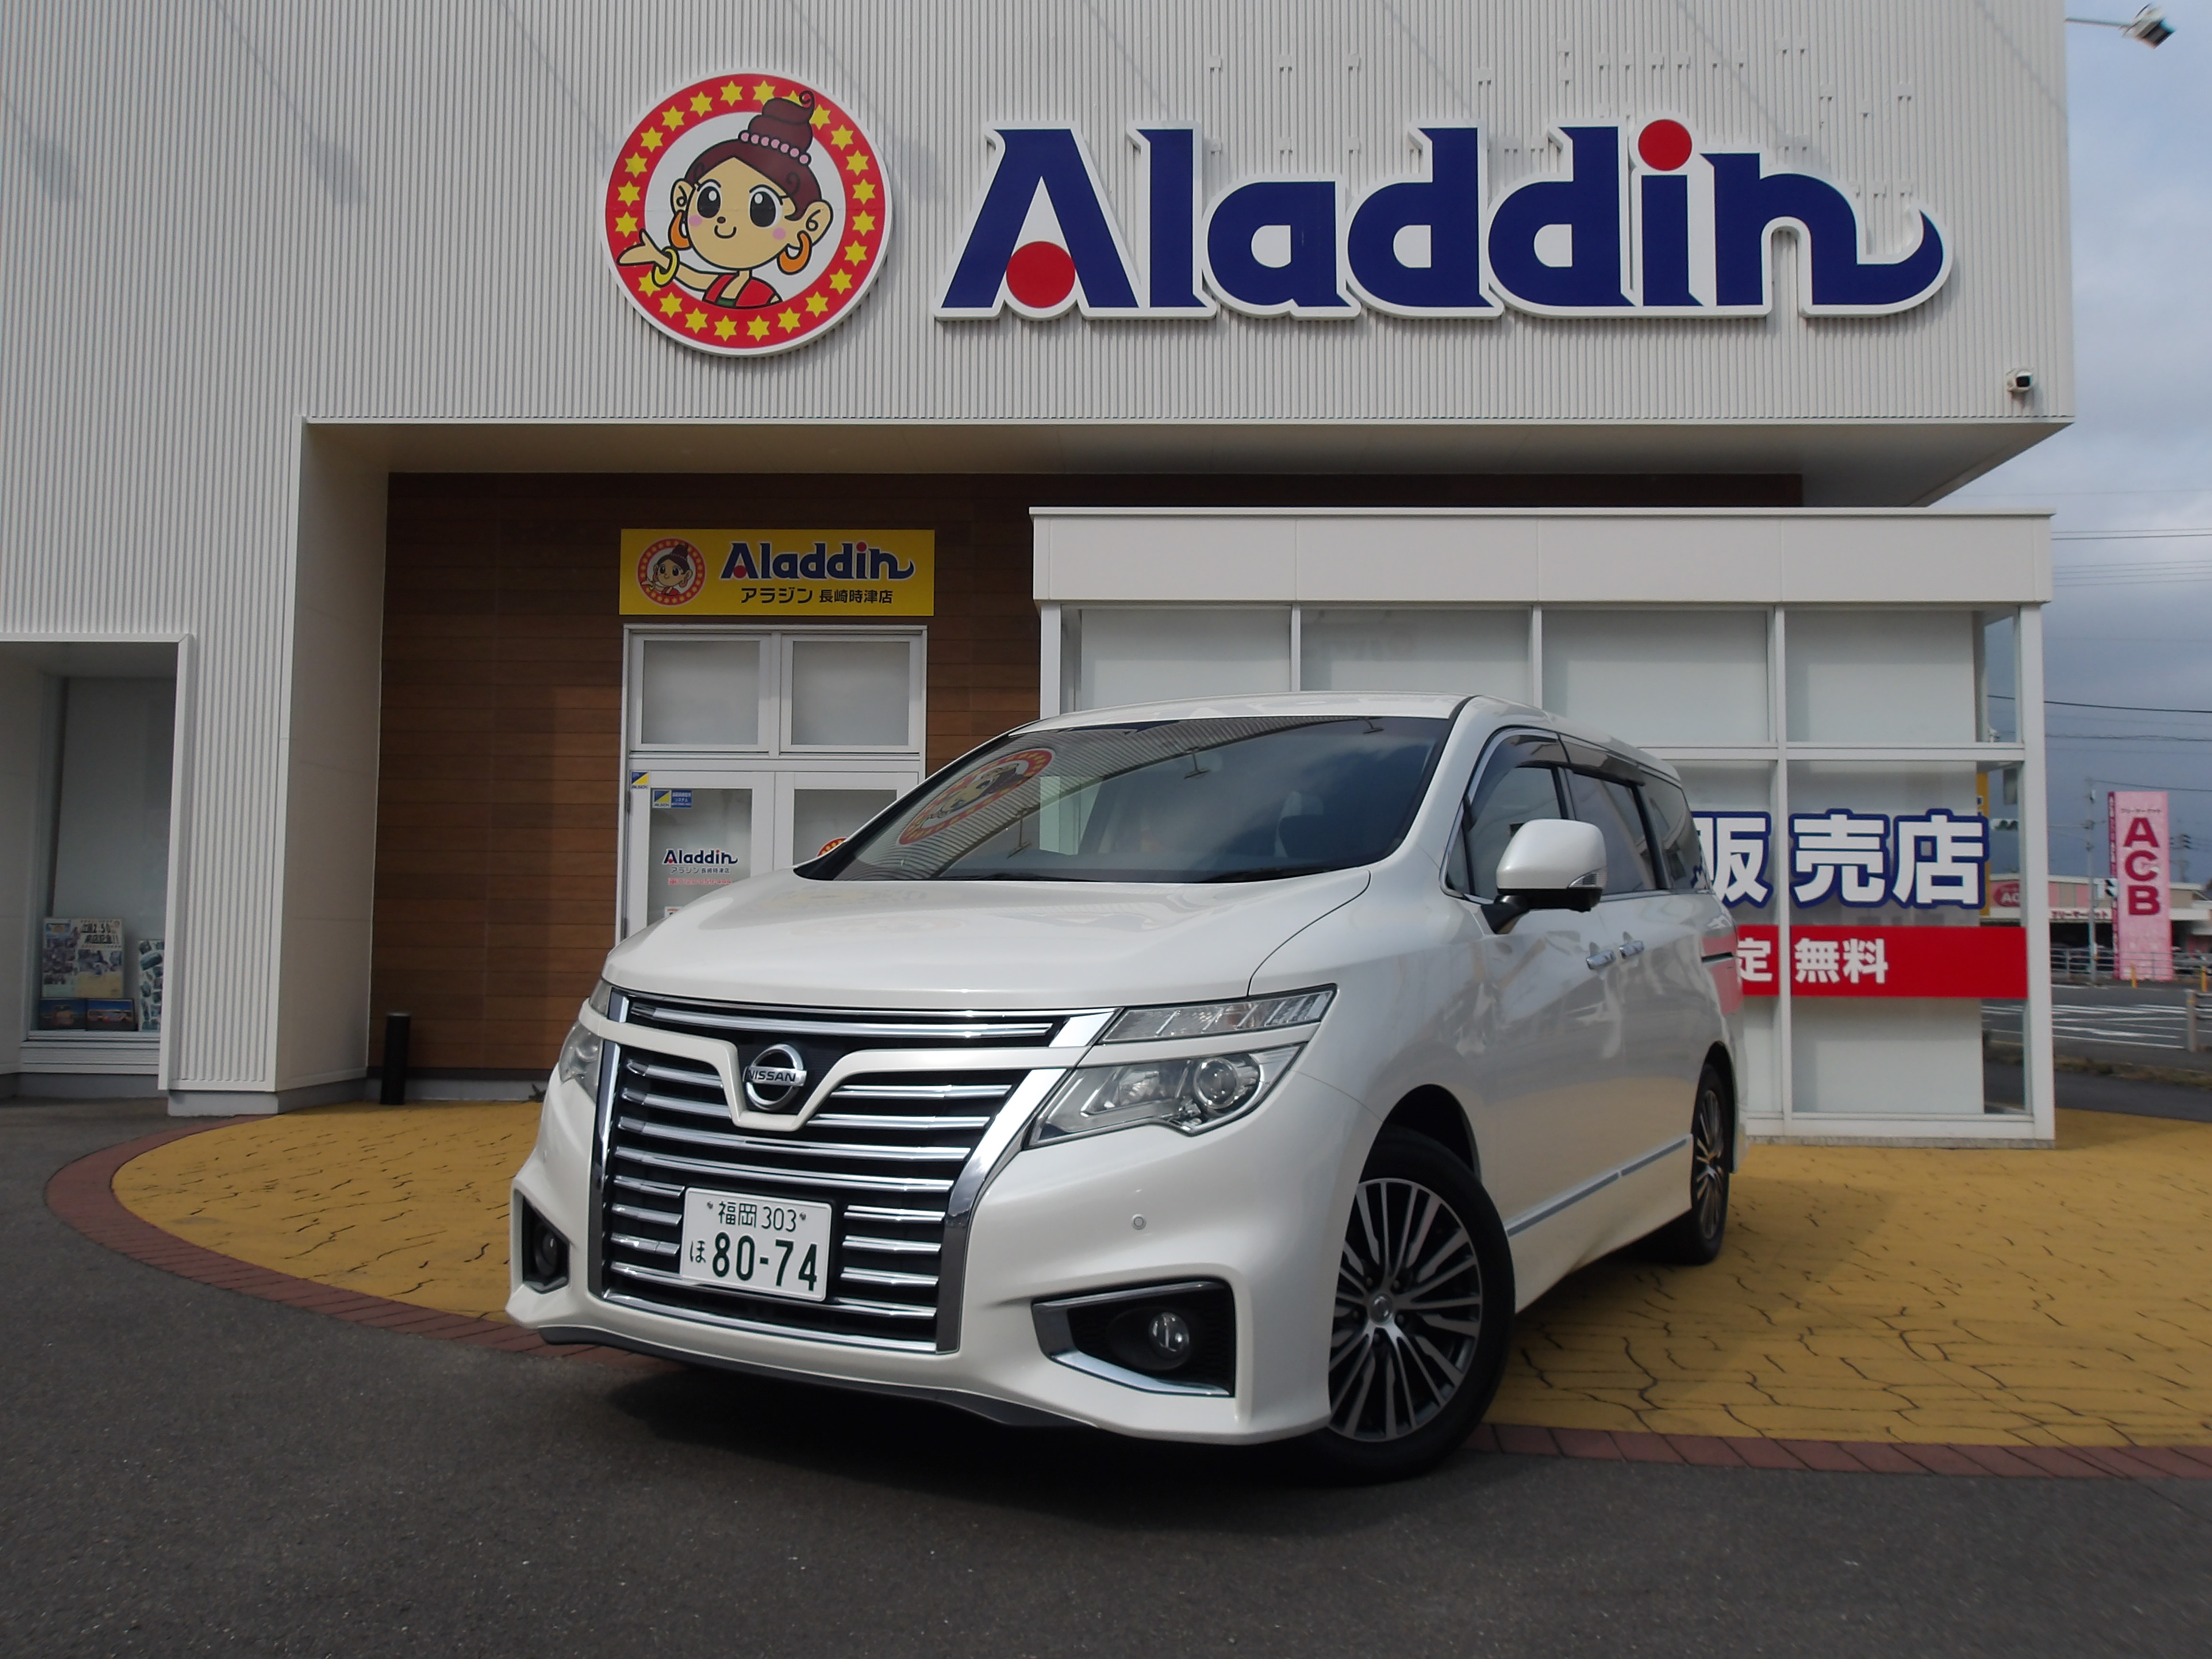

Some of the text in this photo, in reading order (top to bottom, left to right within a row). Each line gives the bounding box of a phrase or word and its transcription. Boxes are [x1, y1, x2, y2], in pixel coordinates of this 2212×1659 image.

[938, 118, 1949, 313] Aladdin
[720, 541, 915, 579] Aladdin
[740, 587, 893, 604] アラジン 長崎時津店
[663, 849, 738, 865] Aladdin
[2123, 817, 2160, 915] ACB
[747, 1069, 797, 1082] NISSAN
[718, 1200, 797, 1233] 福岡 303
[690, 1232, 818, 1292] ほ 80-74
